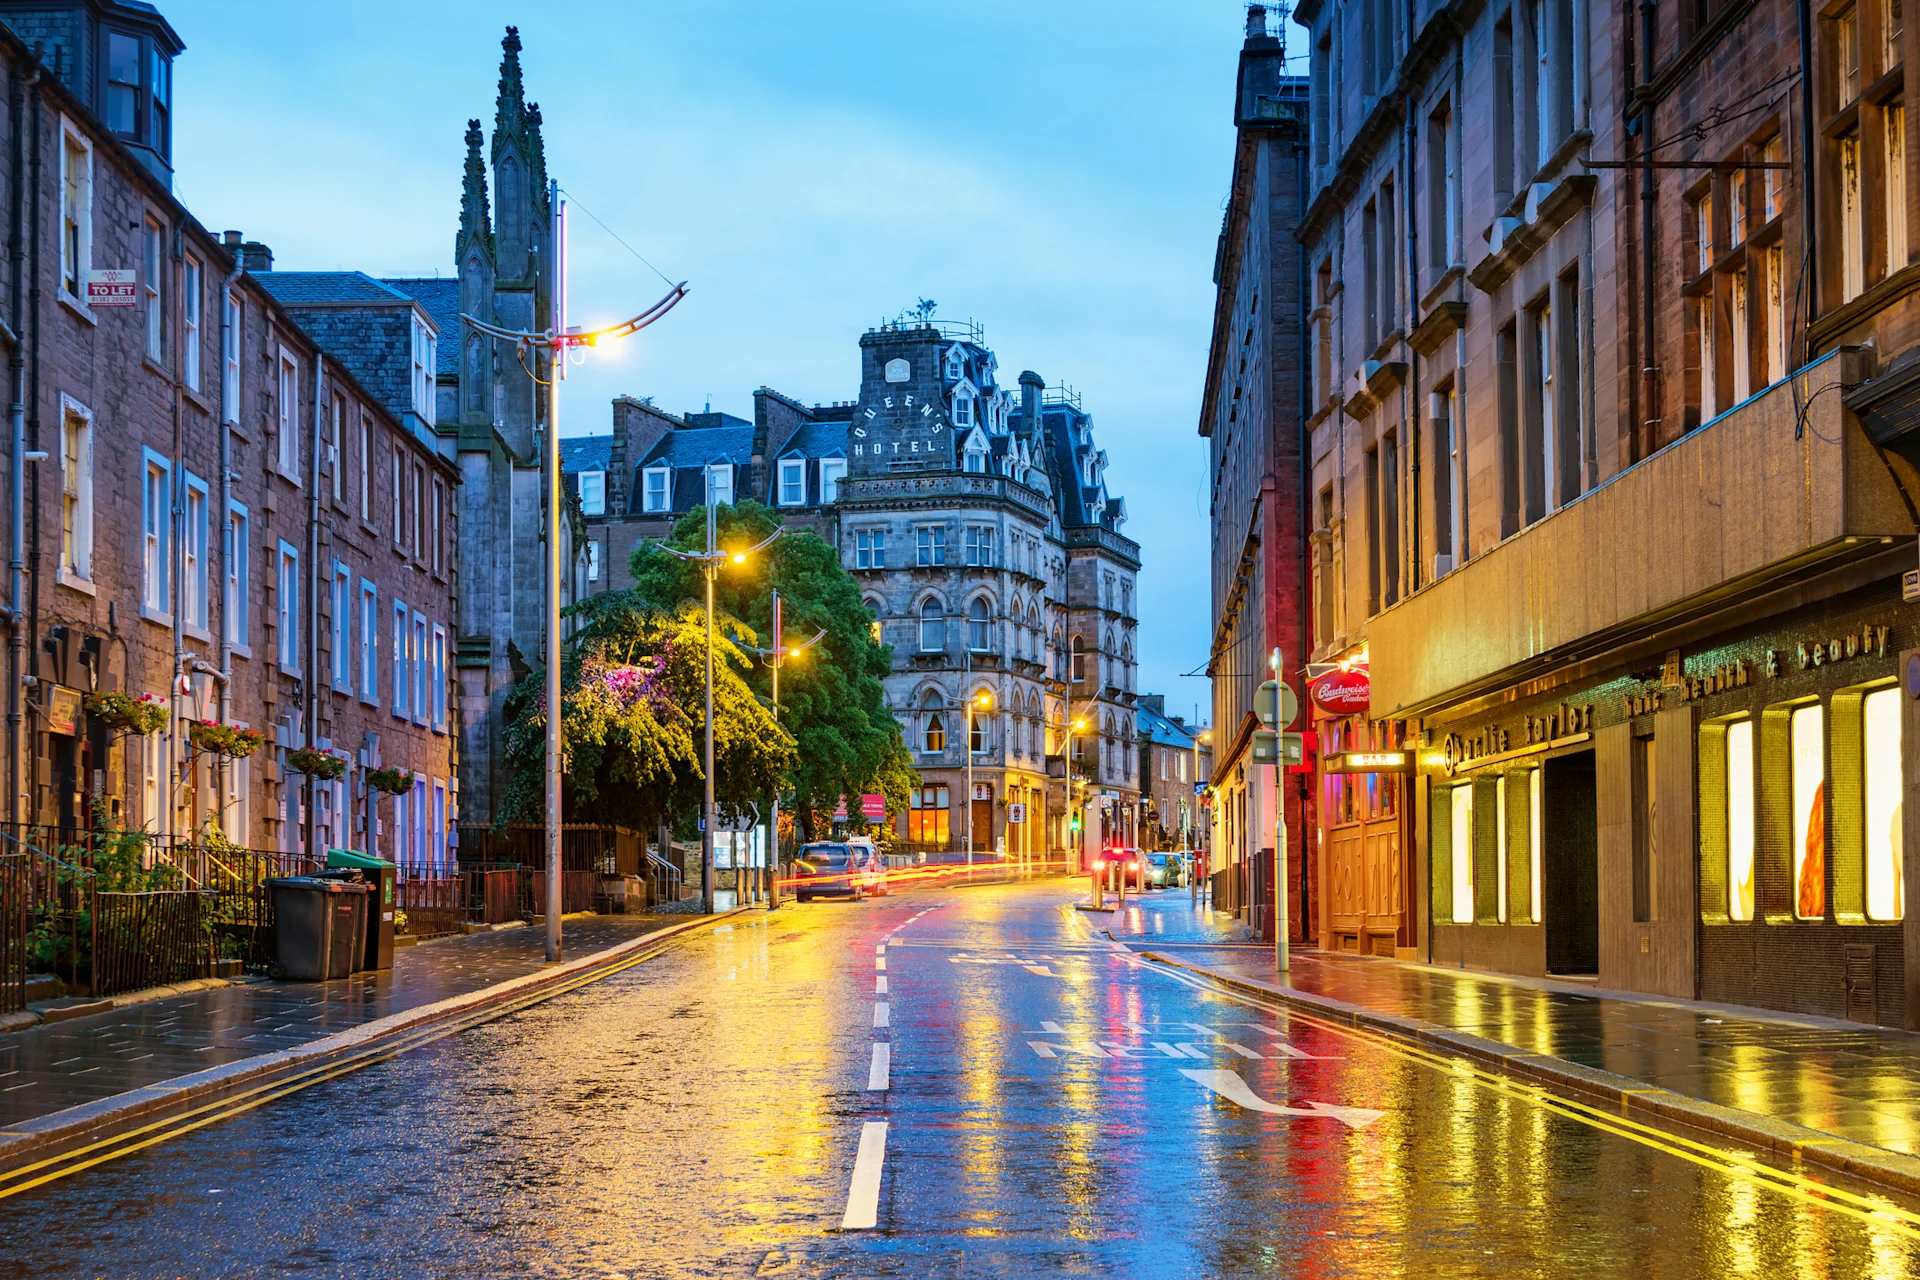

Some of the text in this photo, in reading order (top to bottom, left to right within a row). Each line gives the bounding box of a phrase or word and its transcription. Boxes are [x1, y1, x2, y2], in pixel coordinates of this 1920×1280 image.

[92, 286, 134, 295] TO LET
[854, 395, 943, 438] QUEEN'S
[1623, 688, 1661, 718] hair
[1680, 659, 1748, 702] health
[1766, 650, 1779, 679] &
[1798, 624, 1890, 670] beauty
[1318, 683, 1370, 701] Budweise
[1444, 702, 1594, 777] Charlie taylor
[1363, 754, 1387, 765] BAR
